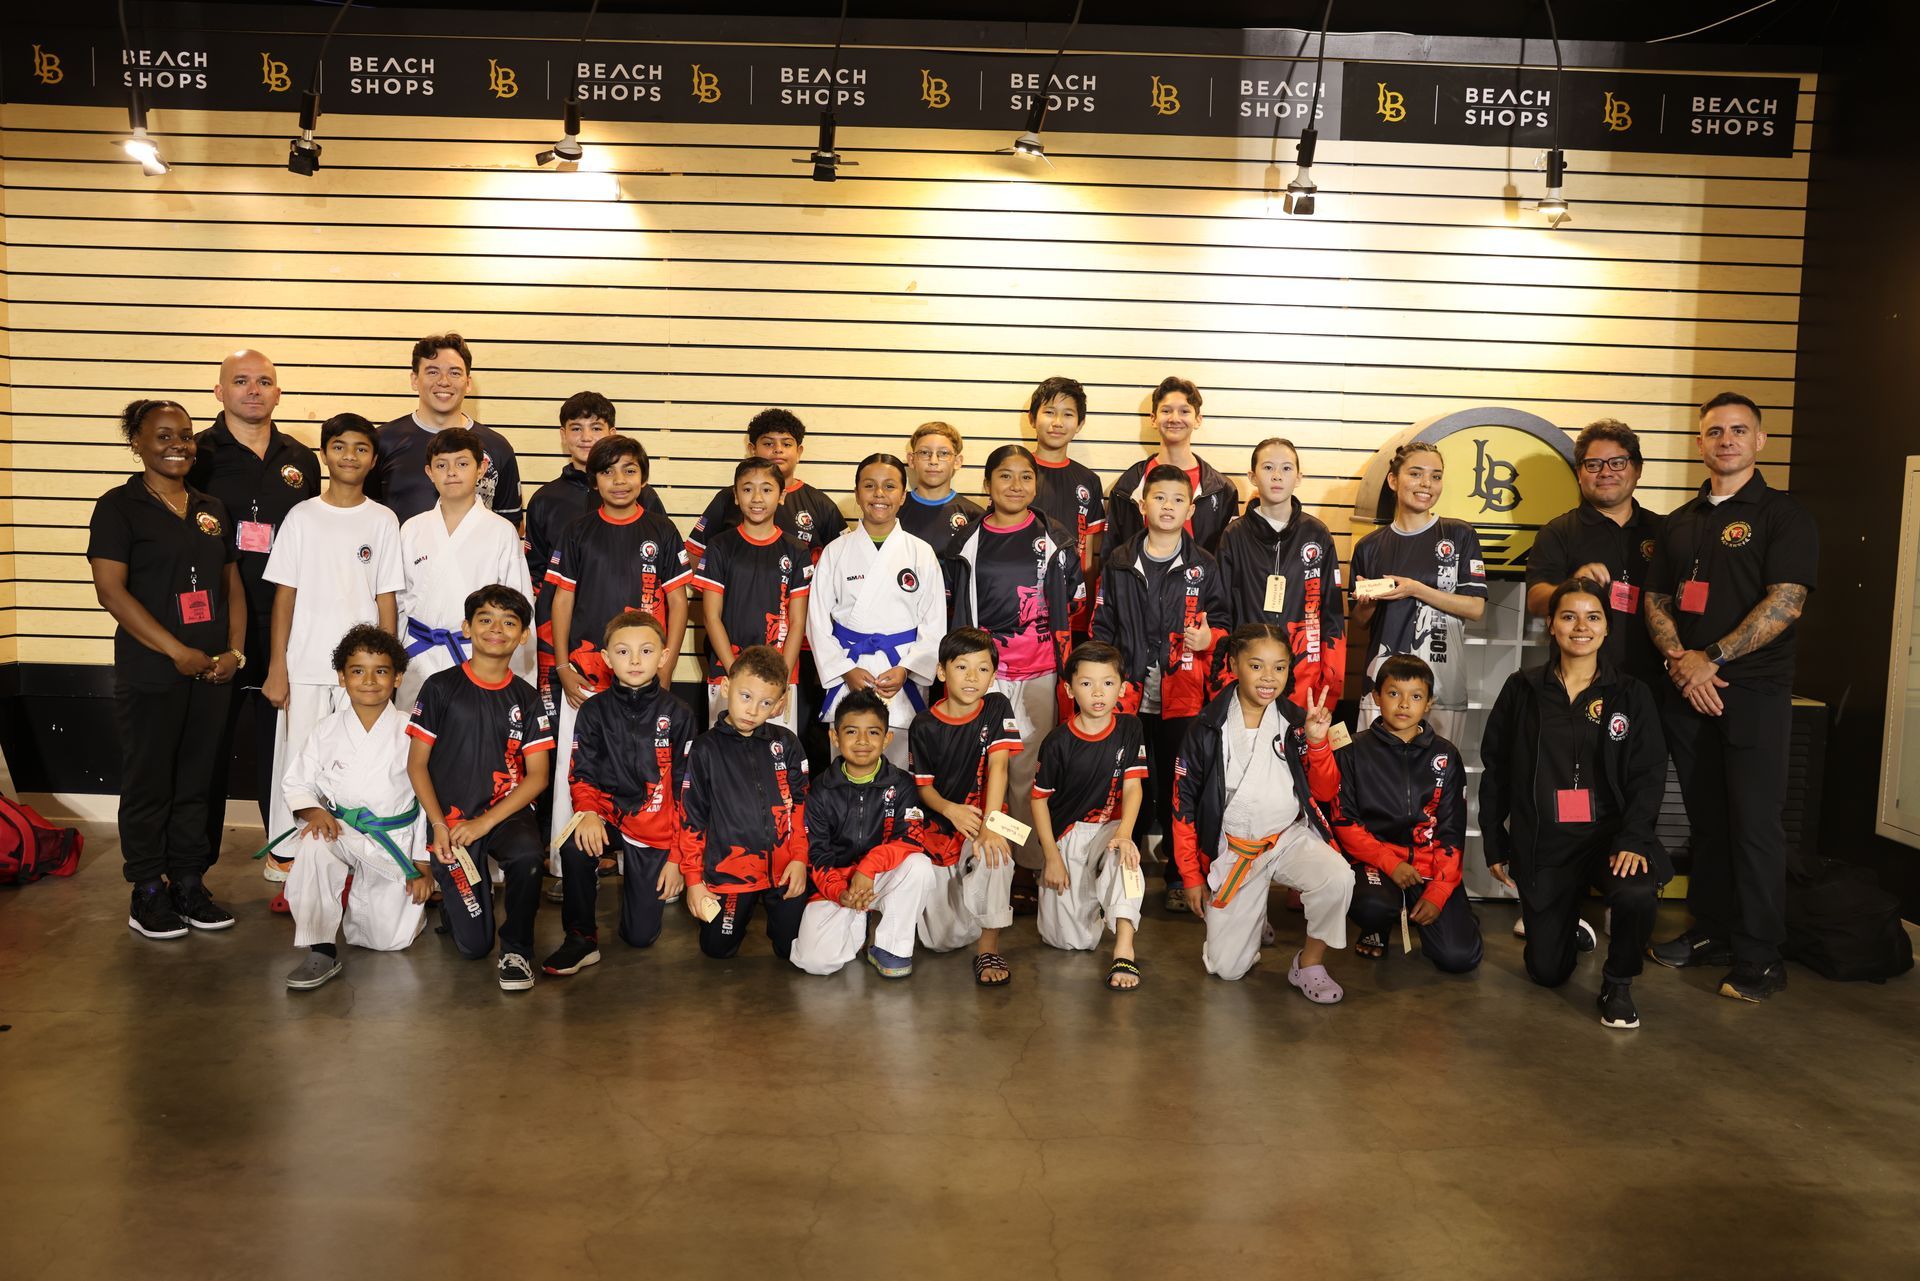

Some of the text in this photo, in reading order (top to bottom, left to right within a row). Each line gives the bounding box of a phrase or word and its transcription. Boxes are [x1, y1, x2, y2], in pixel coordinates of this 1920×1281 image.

[350, 56, 434, 74] BEACH
[577, 63, 662, 80] BEACH
[123, 71, 207, 90] SHOPS
[781, 68, 866, 85] BEACH
[350, 78, 434, 96] SHOPS
[577, 85, 662, 101] SHOPS
[1240, 80, 1326, 98] BEACH
[780, 89, 866, 106] SHOPS
[1465, 88, 1551, 107] BEACH
[1692, 97, 1778, 115] BEACH
[1240, 102, 1325, 119] SHOPS
[1464, 109, 1549, 128] SHOPS
[1691, 118, 1776, 136] SHOPS
[1467, 439, 1523, 514] LB
[642, 563, 657, 574] ZEN
[1304, 567, 1321, 580] ZEN
[1429, 653, 1447, 663] KAN
[654, 738, 669, 748] ZEN
